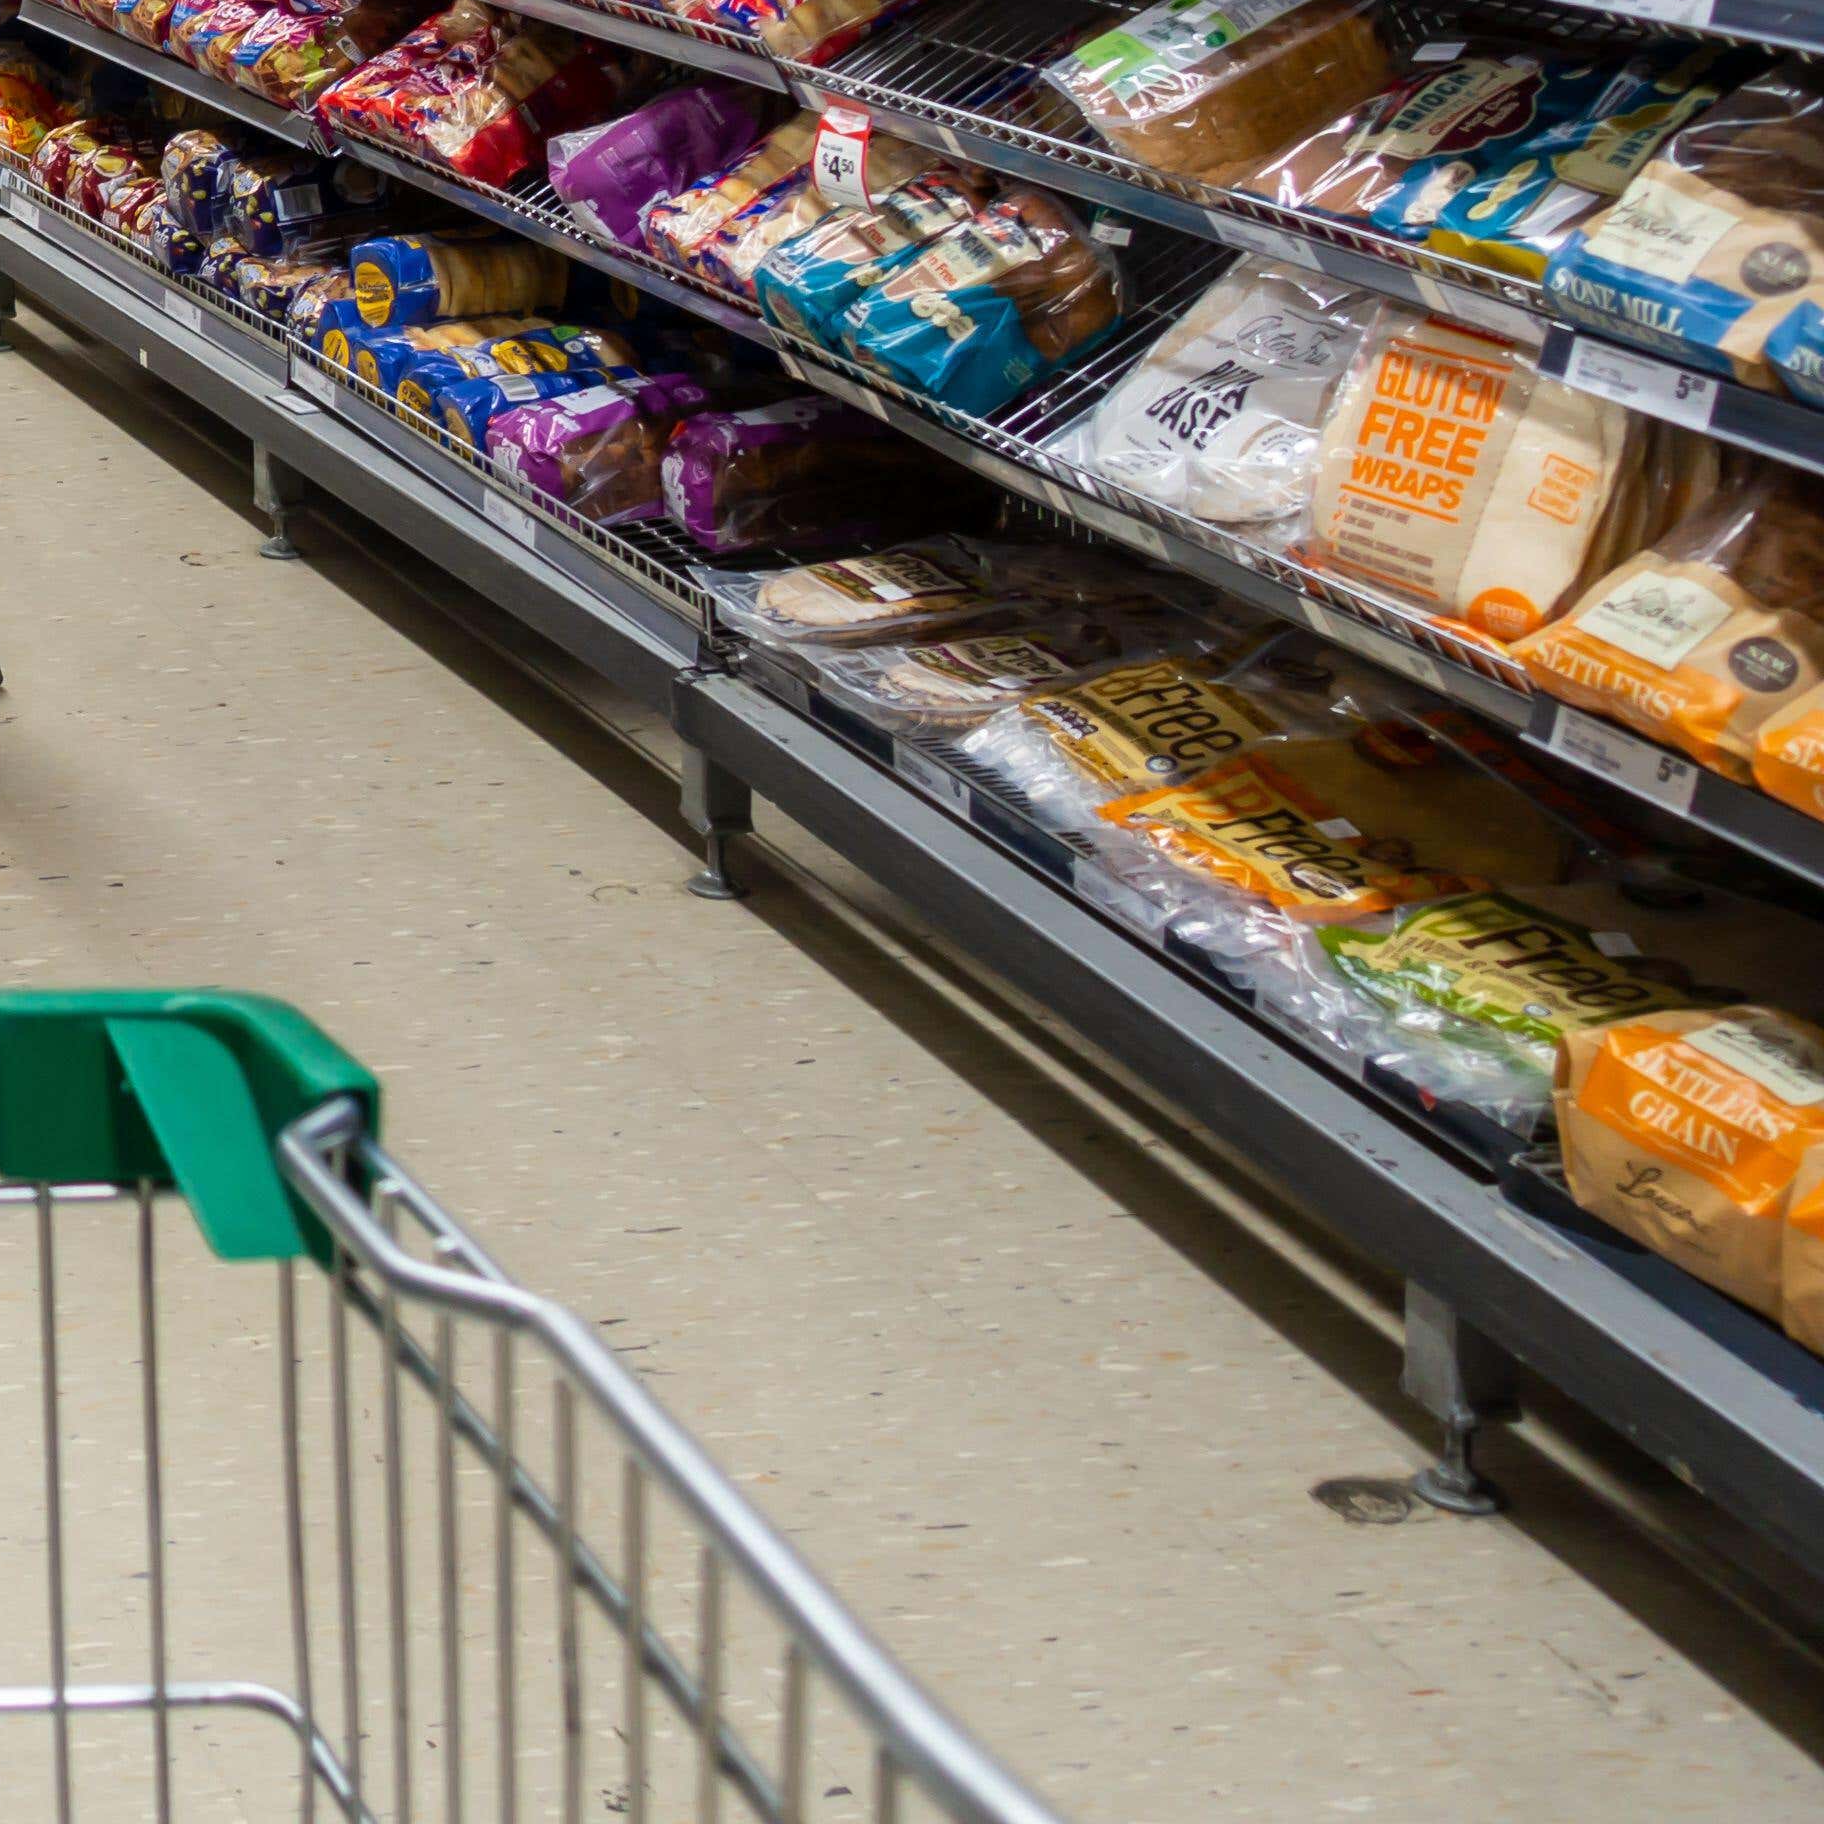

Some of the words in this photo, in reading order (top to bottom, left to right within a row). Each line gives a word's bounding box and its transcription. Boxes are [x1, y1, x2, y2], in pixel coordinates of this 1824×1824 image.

[1619, 292, 1686, 337] MILL
[1374, 351, 1508, 425] GLUTEN
[1359, 401, 1488, 478] FREE
[1350, 452, 1465, 511] WRAPS
[1628, 1088, 1740, 1166] GRAIN
